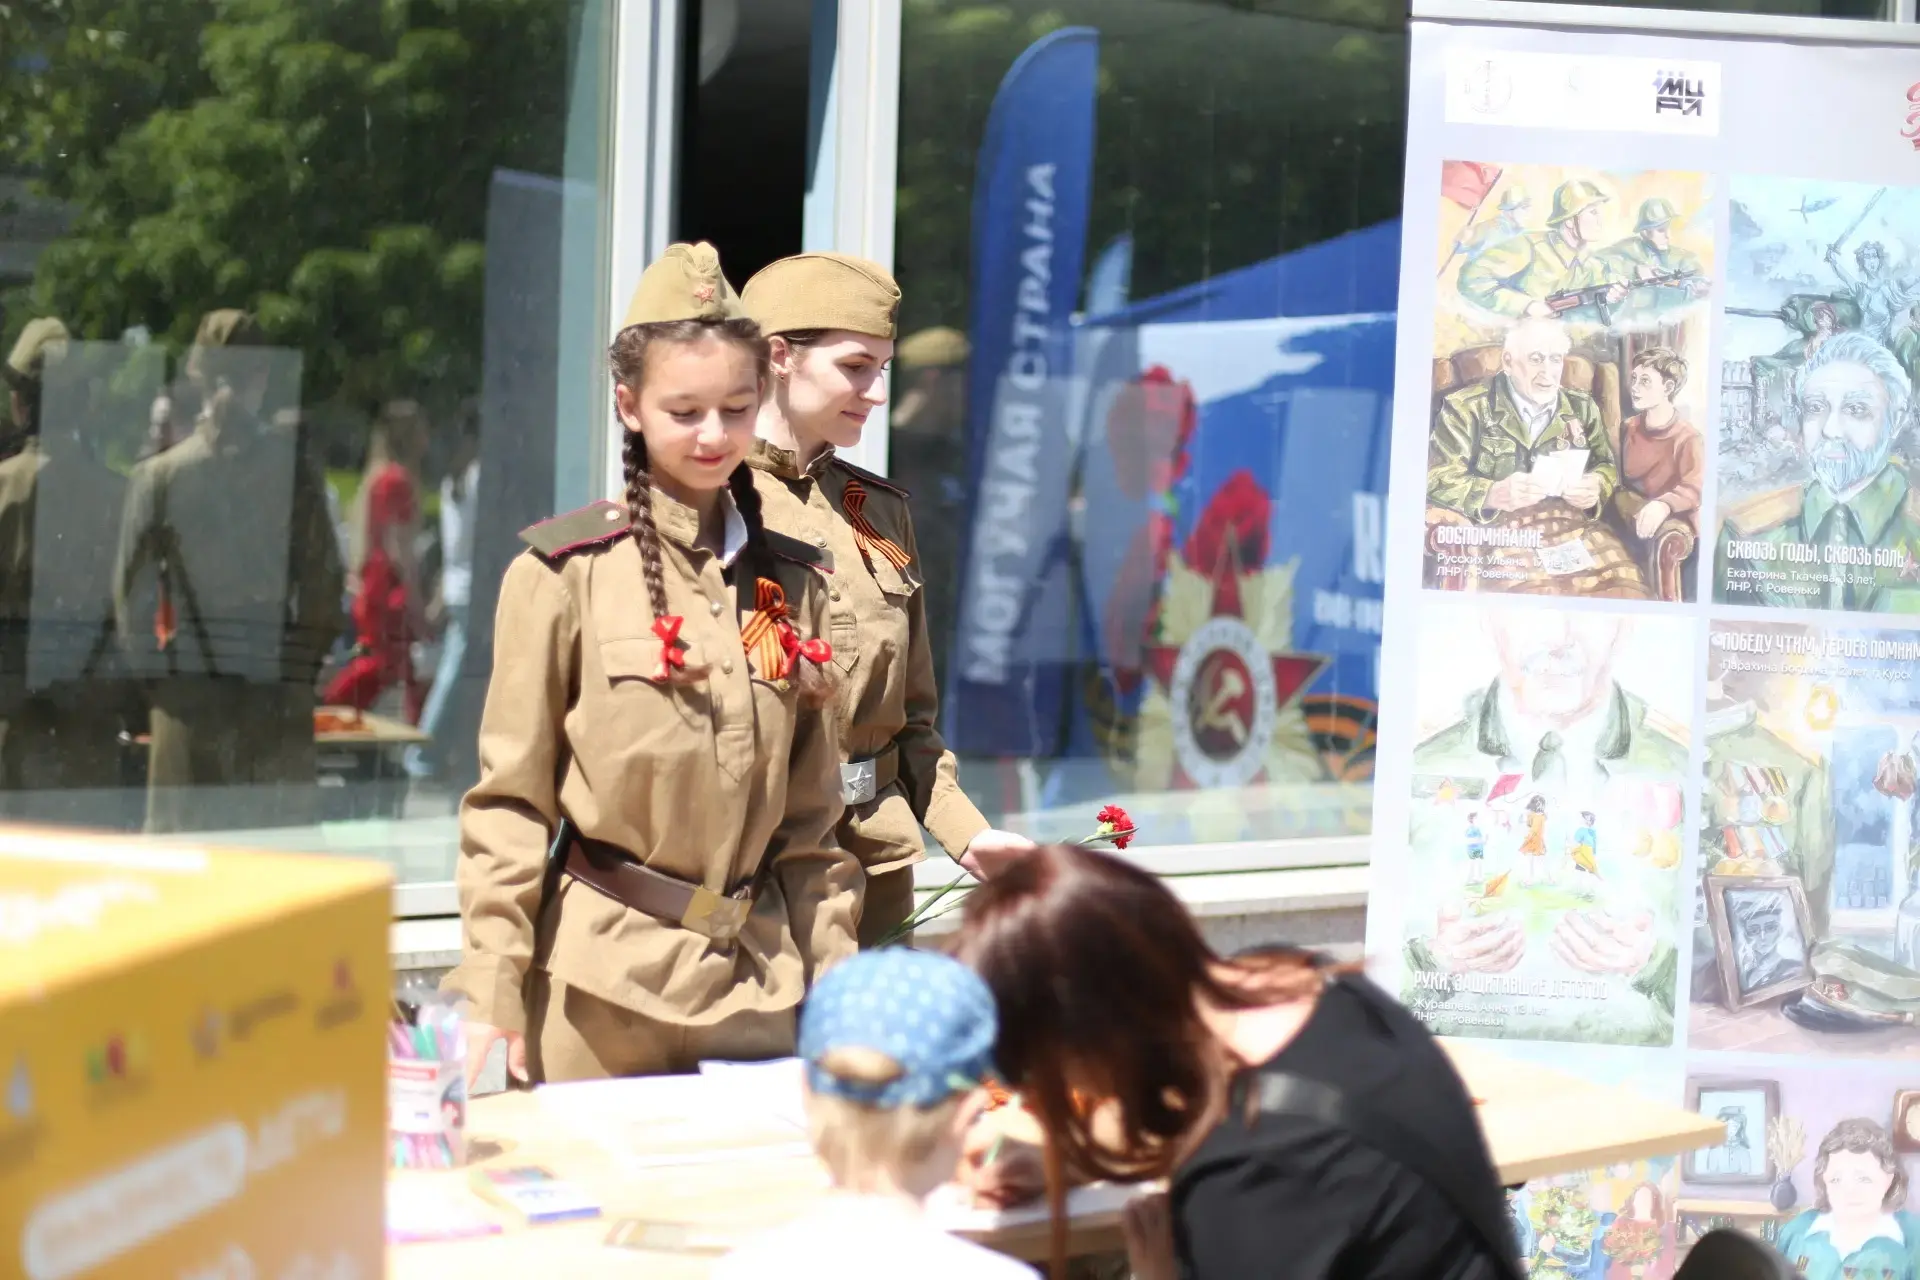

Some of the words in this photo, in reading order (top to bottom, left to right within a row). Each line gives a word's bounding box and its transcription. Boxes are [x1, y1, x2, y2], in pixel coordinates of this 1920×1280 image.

[963, 403, 1043, 686] МОГУЧАЯ
[1011, 162, 1056, 391] СТРАНА
[1437, 525, 1544, 549] ВОСПОМИНАНИЕ
[1437, 552, 1484, 566] Русских
[1726, 539, 1777, 562] СКВОЗЬ
[1780, 543, 1820, 566] ГОДЫ,
[1824, 545, 1872, 566] СКВОЗЬ
[1874, 547, 1905, 568] БОЛЬ
[1436, 566, 1462, 577] ЛНР
[1476, 568, 1528, 581] Ровеньки
[1726, 567, 1787, 583] Екатерина
[1842, 574, 1854, 584] 13
[1725, 581, 1752, 593] ЛНР,
[1755, 584, 1764, 593] г.
[1766, 583, 1820, 596] Ровеньки
[1722, 632, 1773, 654] ПОБЕДУ
[1822, 637, 1868, 658] ГЕРОЕВ
[1870, 640, 1920, 661] ПОМНИМ
[1413, 971, 1451, 992] РУКИ,
[1450, 1013, 1504, 1026] Ровеньки
